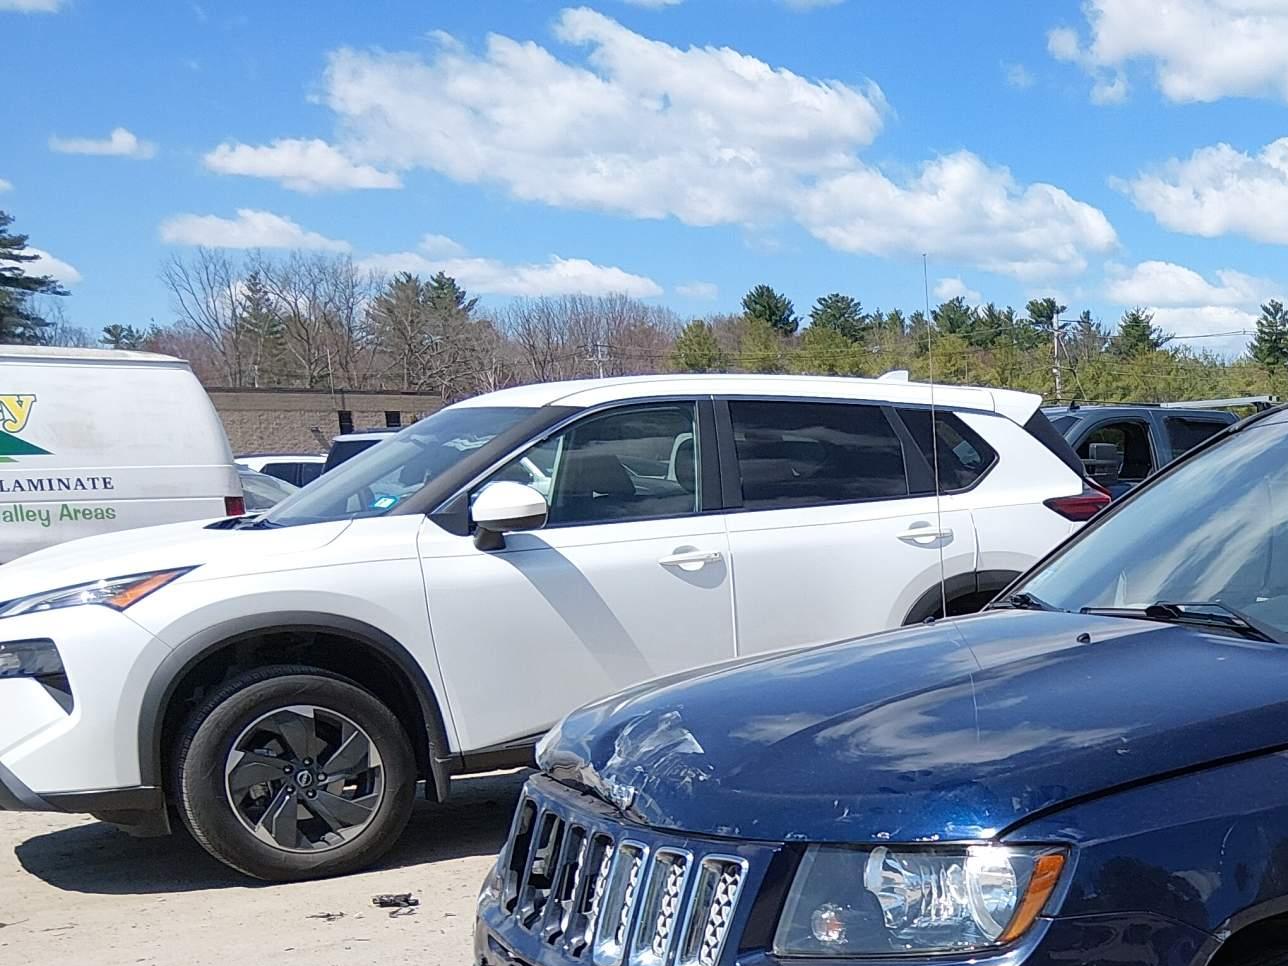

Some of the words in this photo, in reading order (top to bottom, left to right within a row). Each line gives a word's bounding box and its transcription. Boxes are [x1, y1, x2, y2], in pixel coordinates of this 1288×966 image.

[0, 394, 37, 433] y
[0, 477, 114, 492] LAMINATE
[60, 504, 116, 521] Areas
